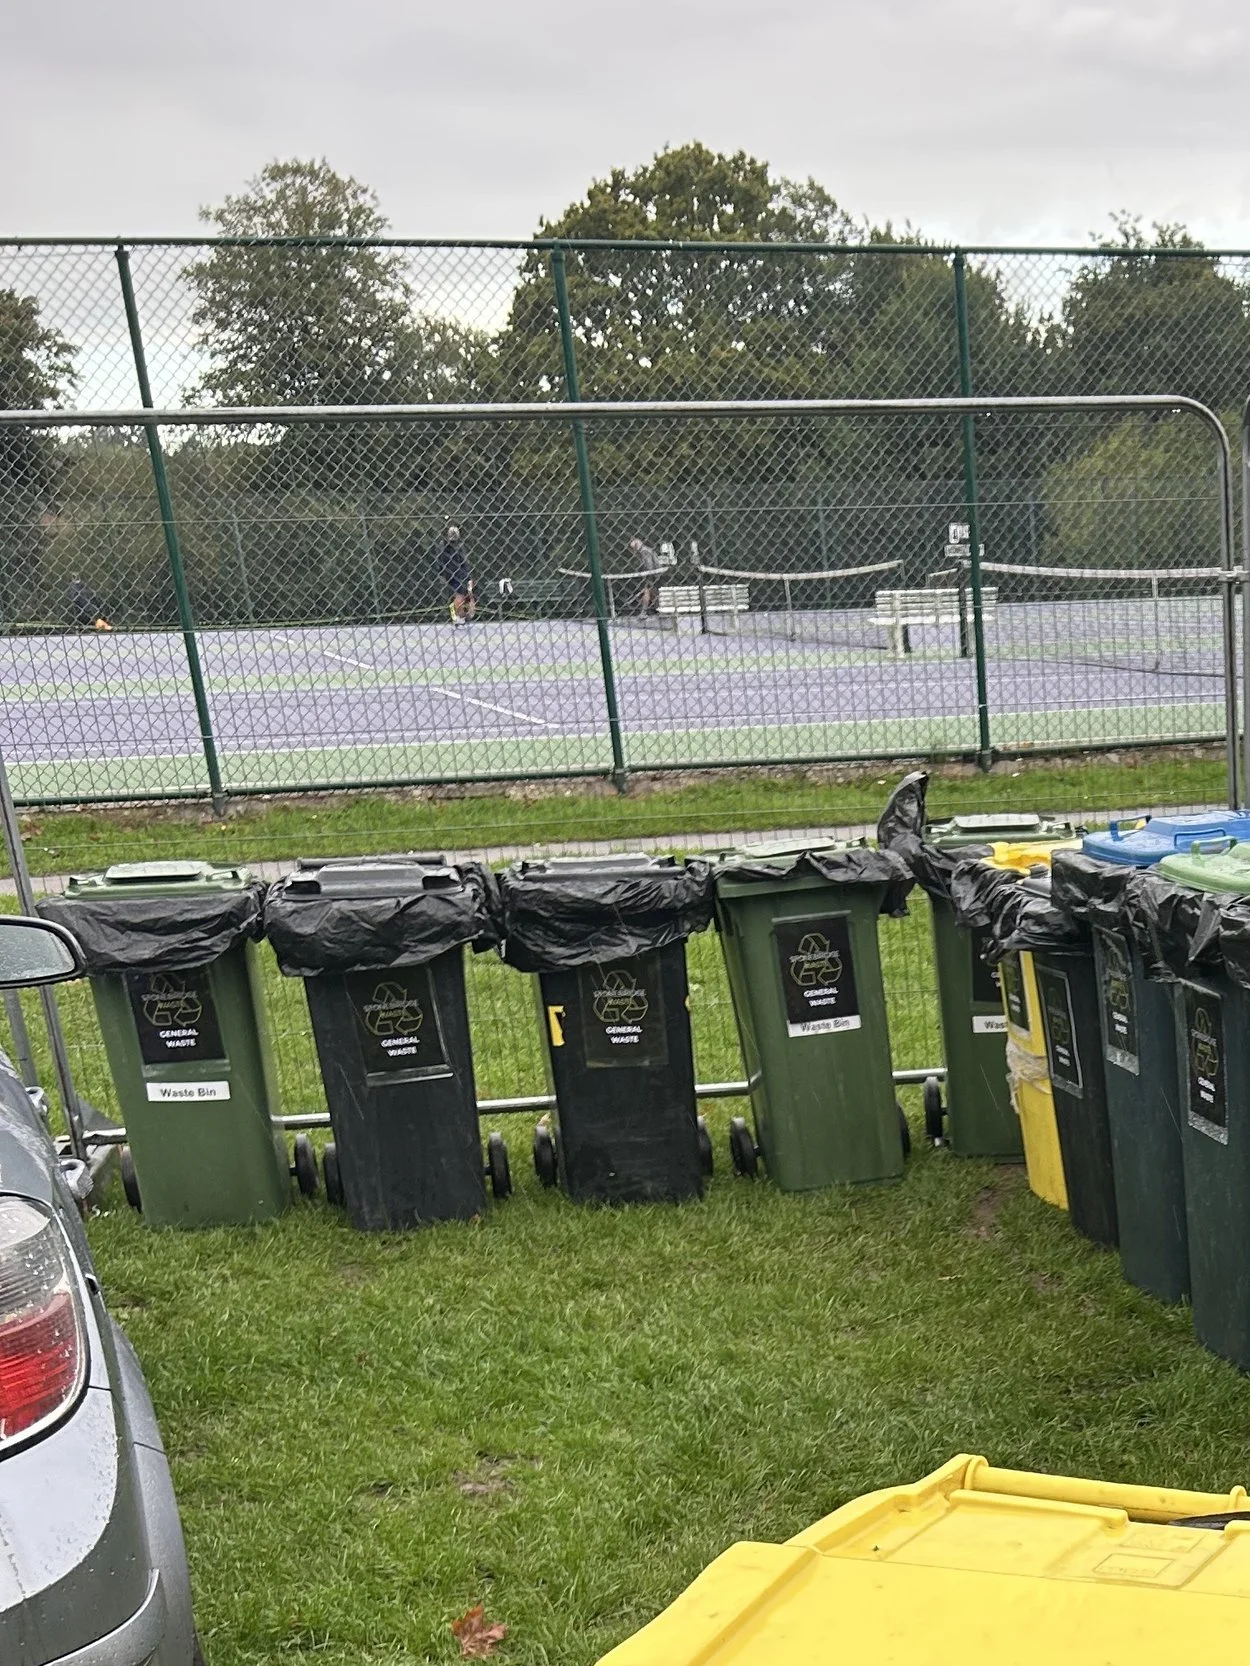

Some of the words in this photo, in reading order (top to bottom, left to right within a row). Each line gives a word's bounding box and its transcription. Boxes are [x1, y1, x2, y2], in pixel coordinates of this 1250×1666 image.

[803, 987, 839, 997] GENERAL
[809, 997, 837, 1007] WASTE
[160, 1028, 199, 1038] GENERAL
[605, 1026, 643, 1035] GENERAL
[165, 1038, 196, 1048] WASTE
[381, 1036, 420, 1048] GENERAL
[610, 1035, 639, 1044] WASTE
[387, 1046, 417, 1057] WASTE
[160, 1087, 195, 1098] Waste
[198, 1087, 216, 1097] Bin
